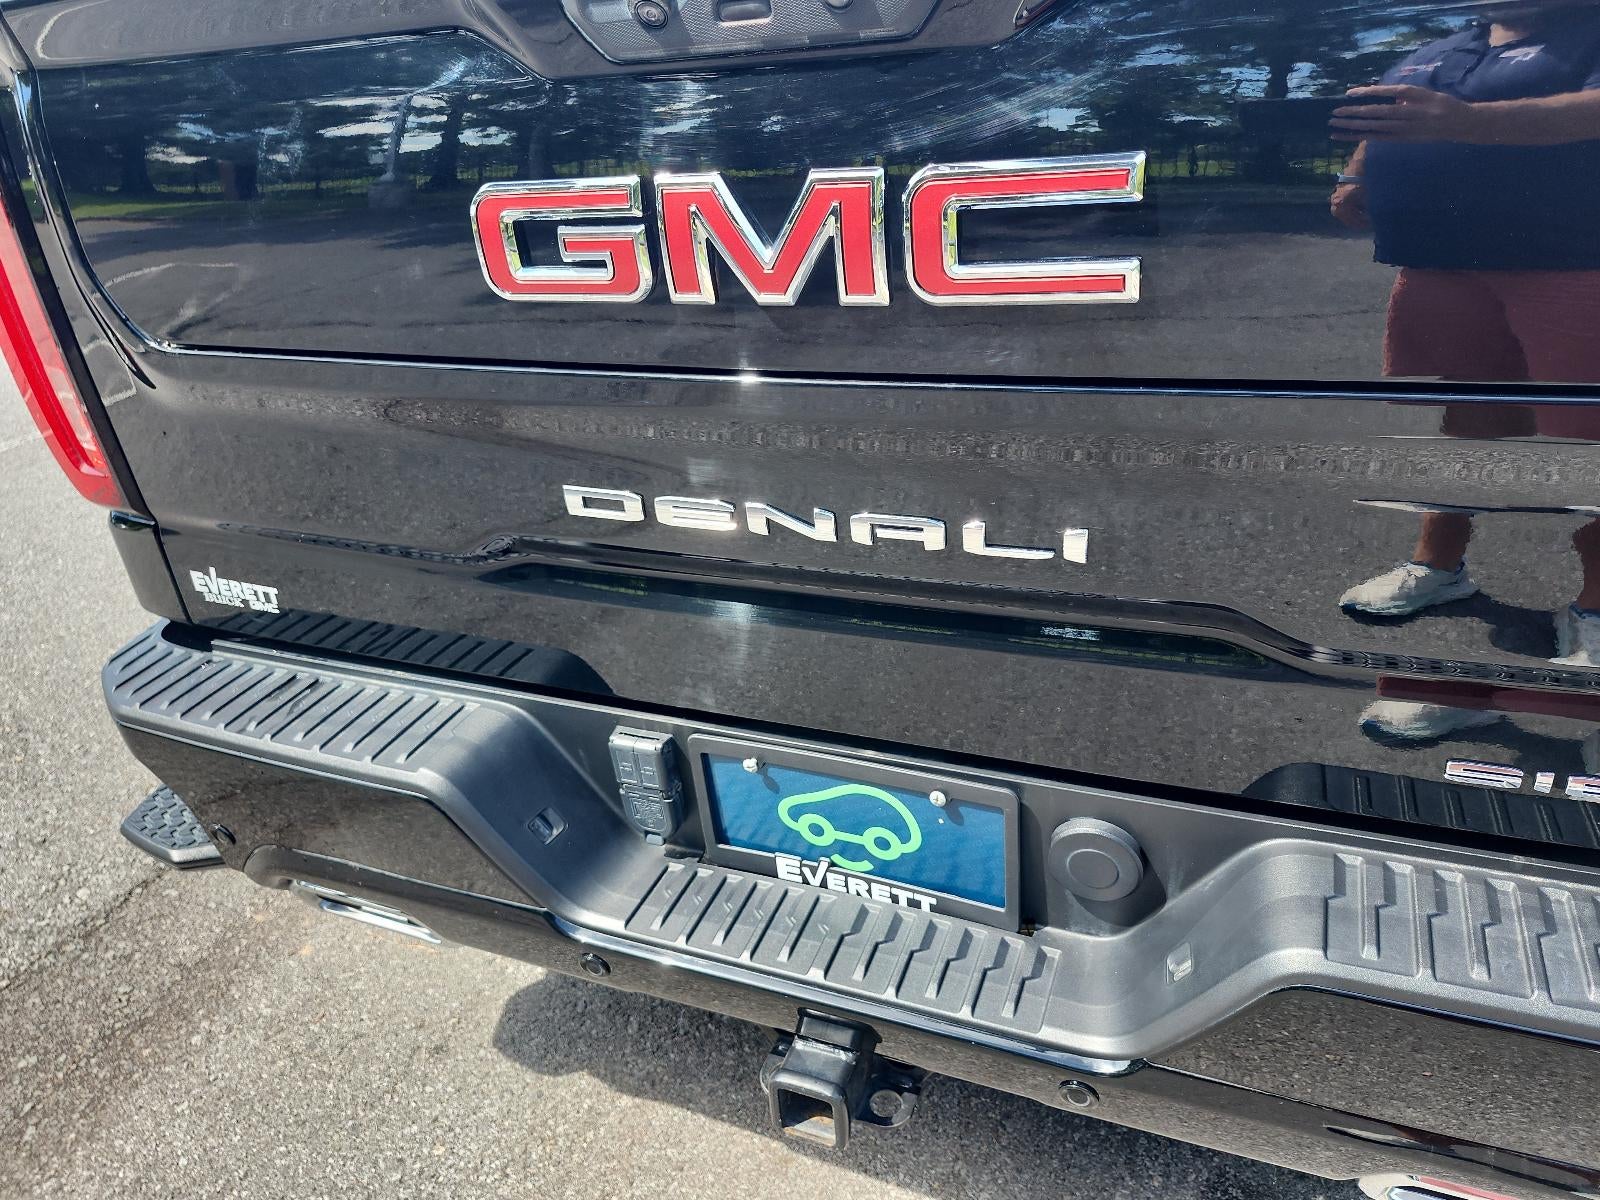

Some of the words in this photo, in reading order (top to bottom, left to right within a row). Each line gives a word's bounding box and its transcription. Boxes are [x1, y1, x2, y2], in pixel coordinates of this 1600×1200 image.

[470, 151, 1147, 307] GMC
[562, 484, 1089, 563] DENALI
[189, 566, 279, 605] EVERETT
[249, 599, 280, 614] GMC
[775, 853, 938, 913] EVERETT
